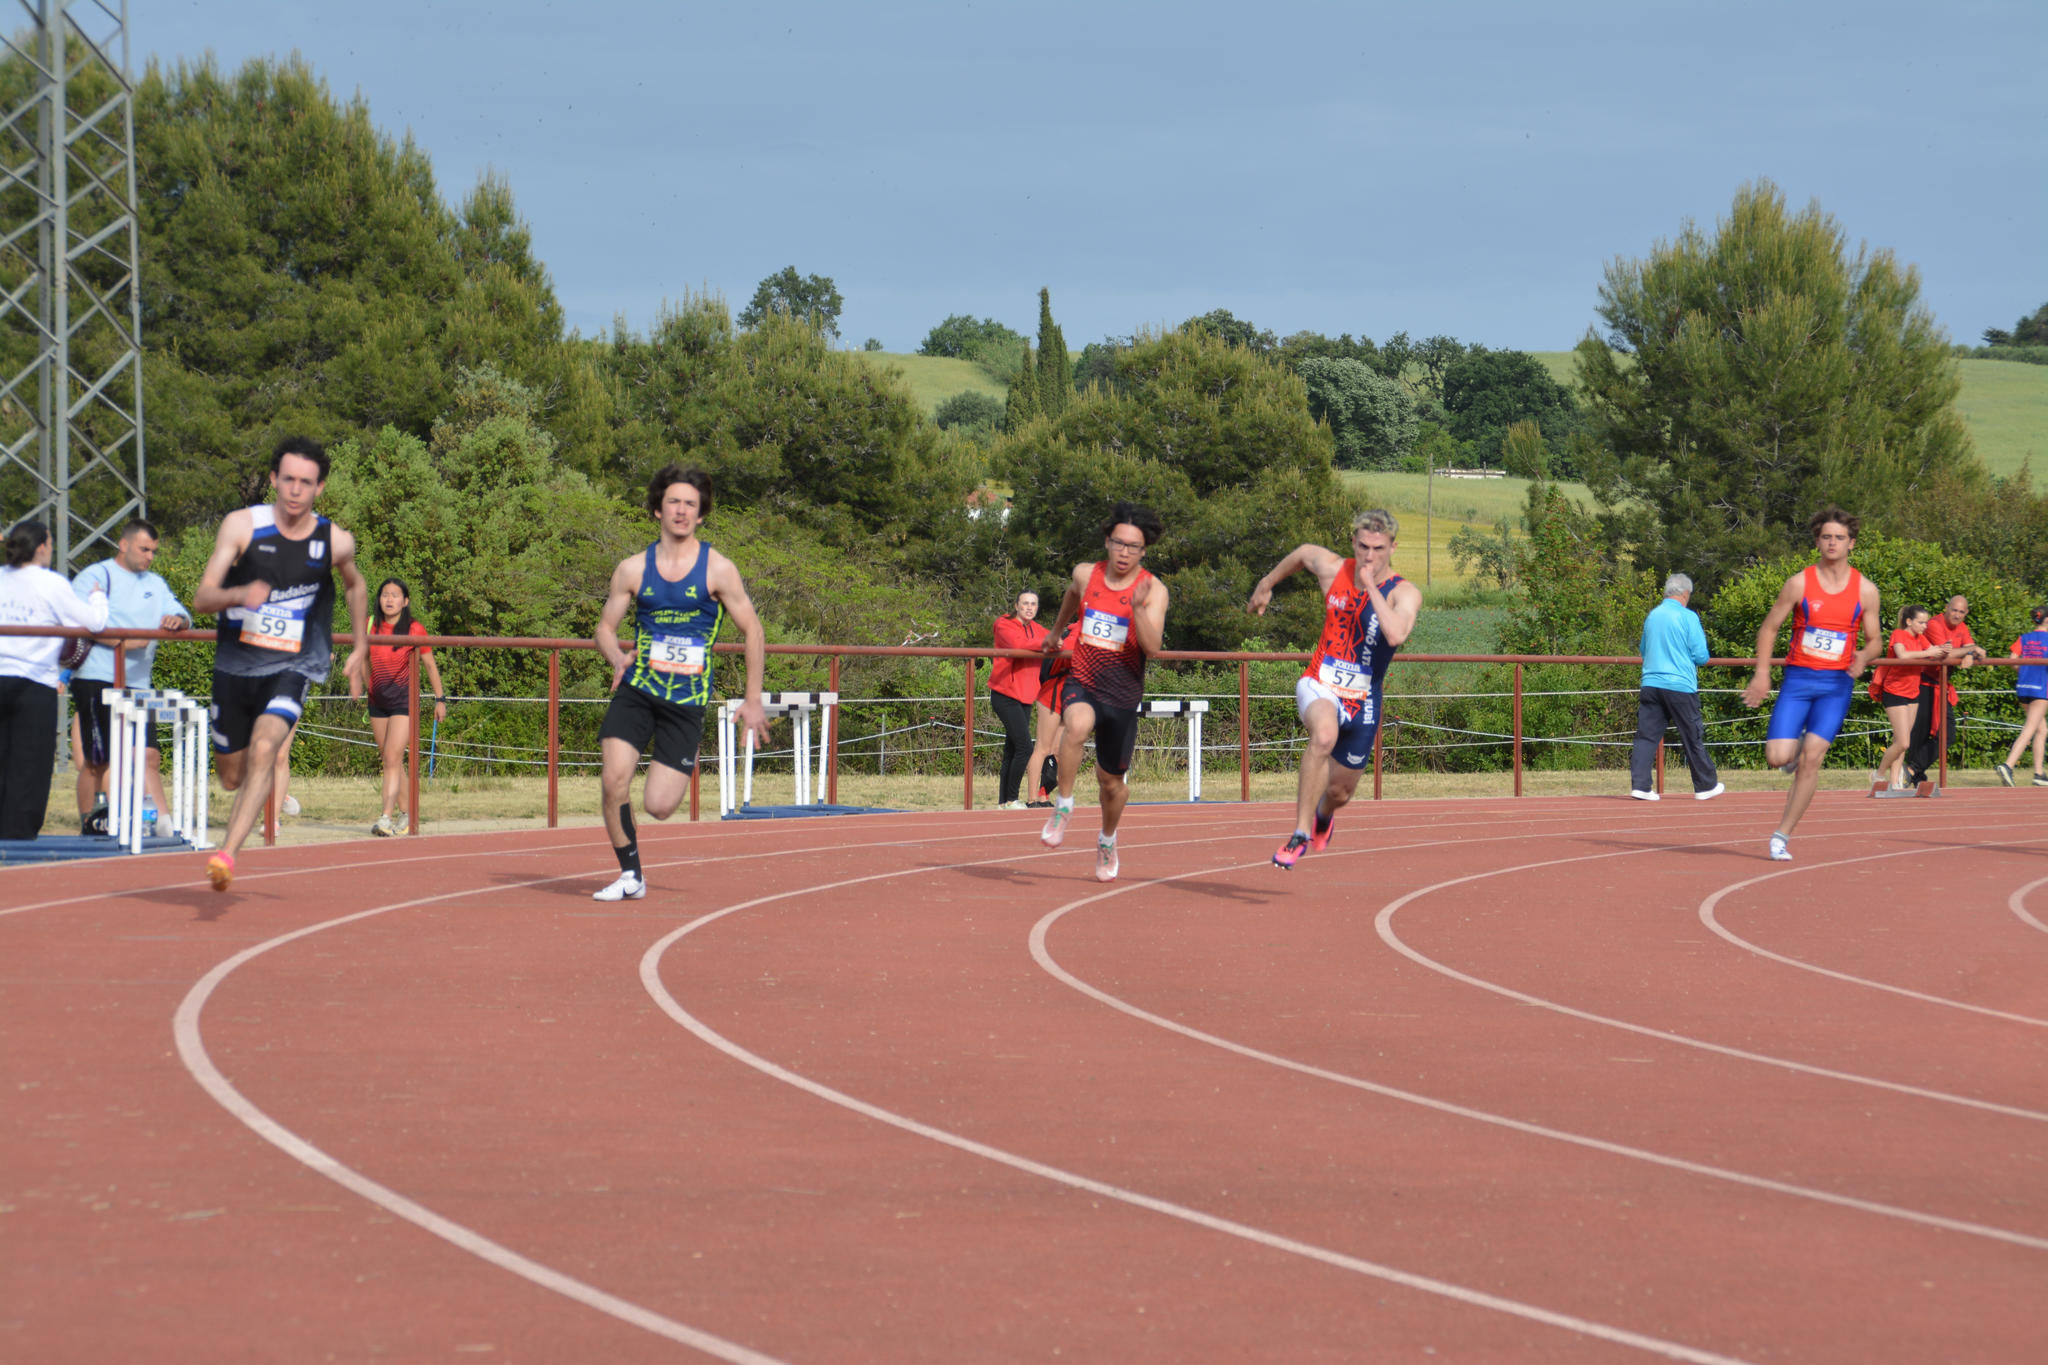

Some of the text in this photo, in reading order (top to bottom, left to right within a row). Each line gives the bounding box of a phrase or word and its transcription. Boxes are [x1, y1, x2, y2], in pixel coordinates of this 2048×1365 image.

[259, 617, 287, 637] 59
[1092, 621, 1112, 638] 63
[1813, 636, 1833, 651] 53
[665, 645, 688, 663] 55
[1332, 670, 1356, 688] 57
